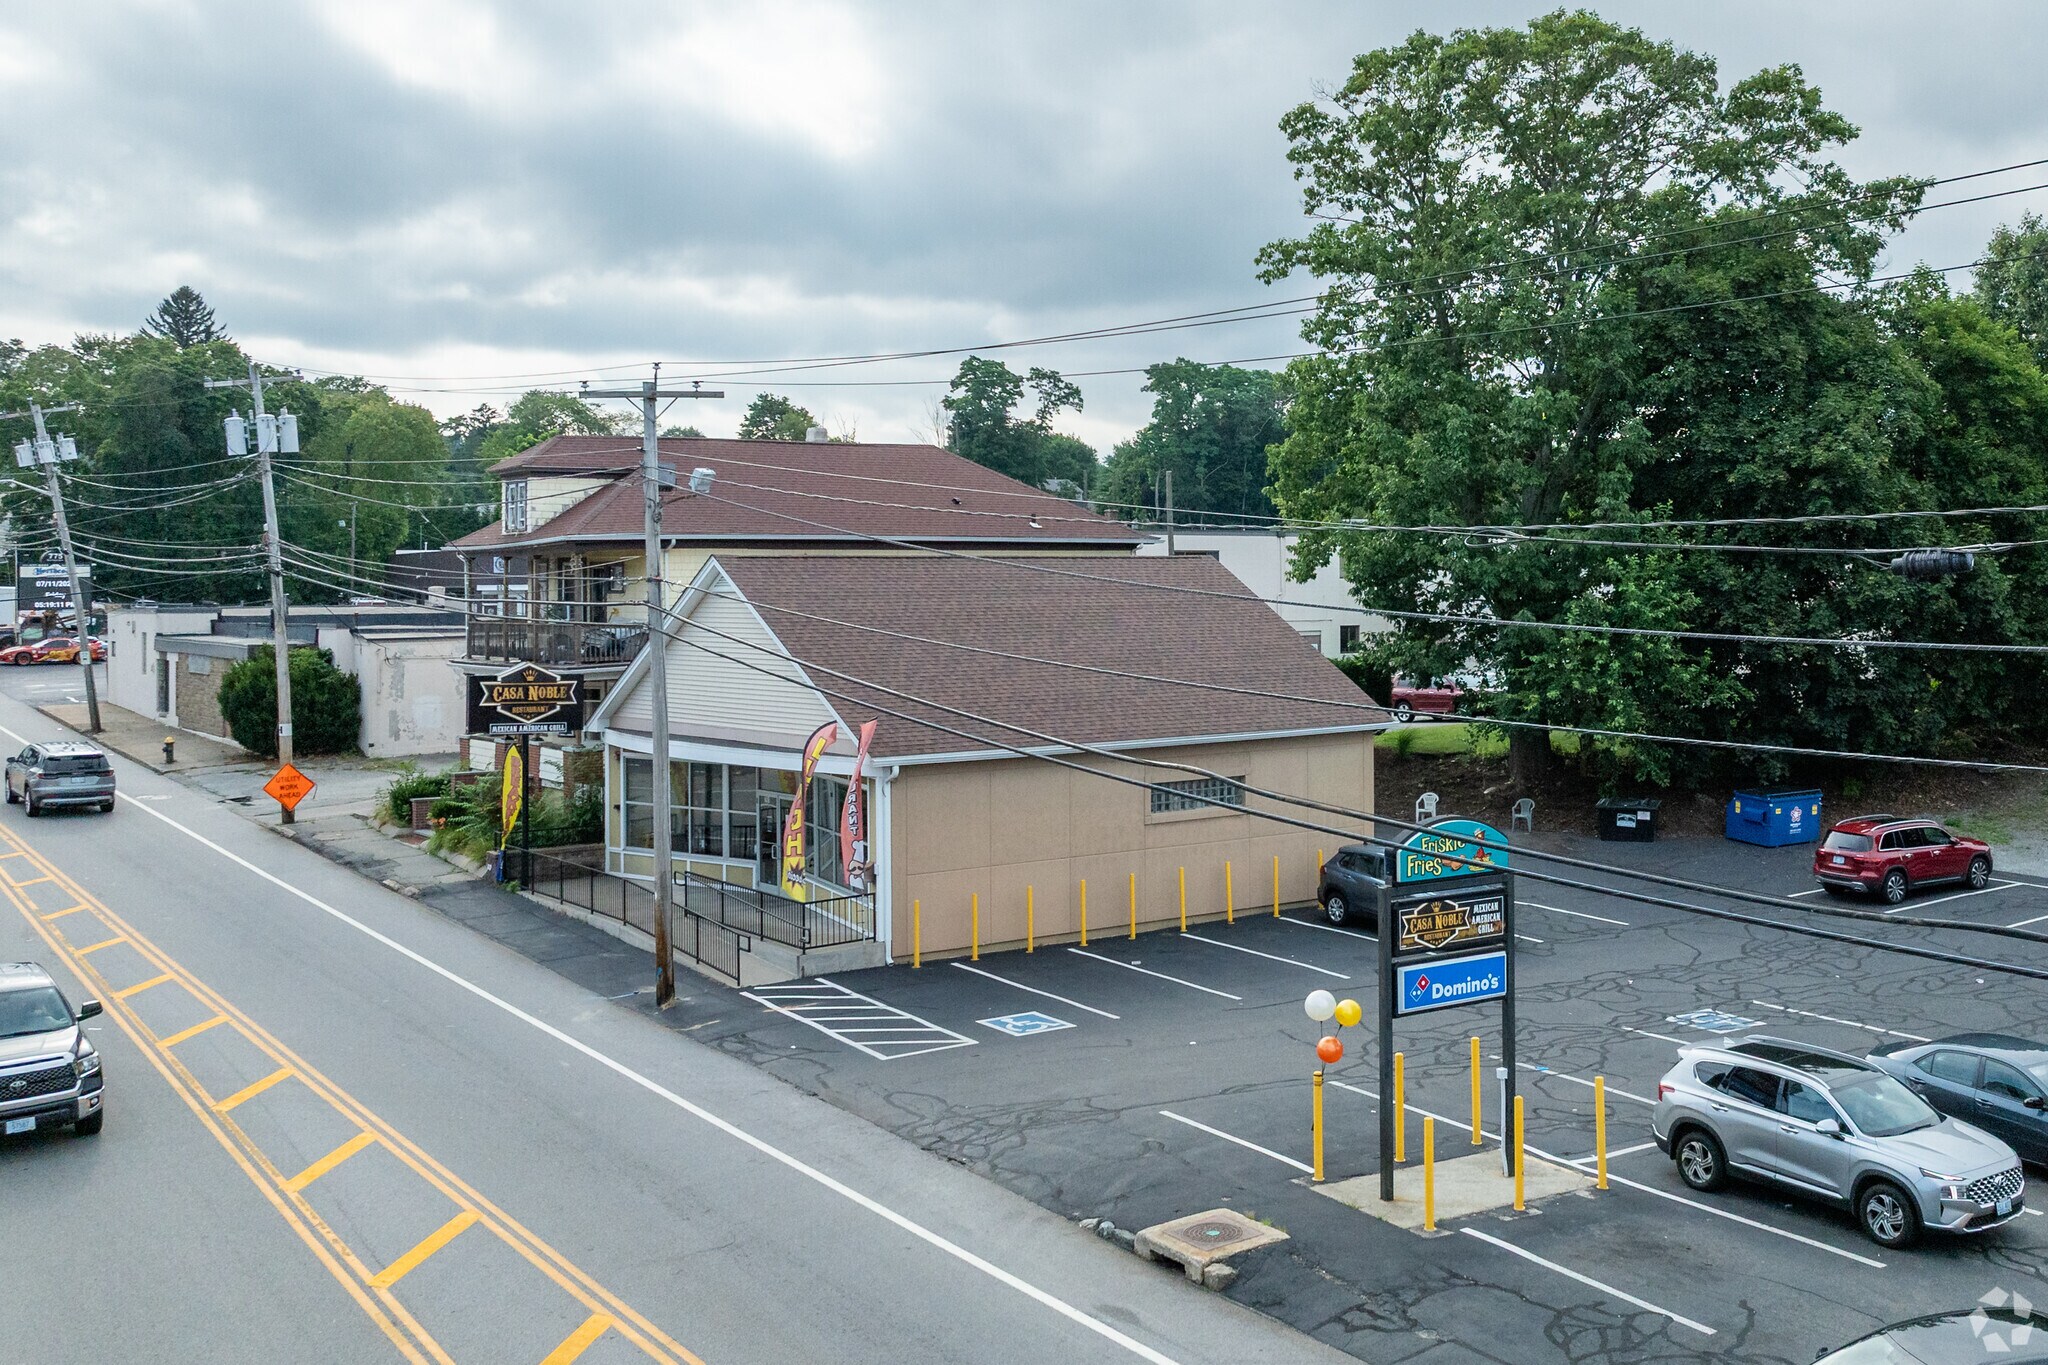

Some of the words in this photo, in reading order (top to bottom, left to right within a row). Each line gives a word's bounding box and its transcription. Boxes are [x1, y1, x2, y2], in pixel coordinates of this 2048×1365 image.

[511, 706, 550, 714] RESTAURANT
[491, 725, 517, 733] MEXICAN
[518, 724, 548, 732] AMERICAN
[278, 791, 301, 799] AHEAD
[1473, 902, 1499, 914] MEXICAN
[1471, 912, 1501, 924] AMERICAN
[1477, 922, 1495, 935] GRILL
[1432, 973, 1499, 1000] Domino's
